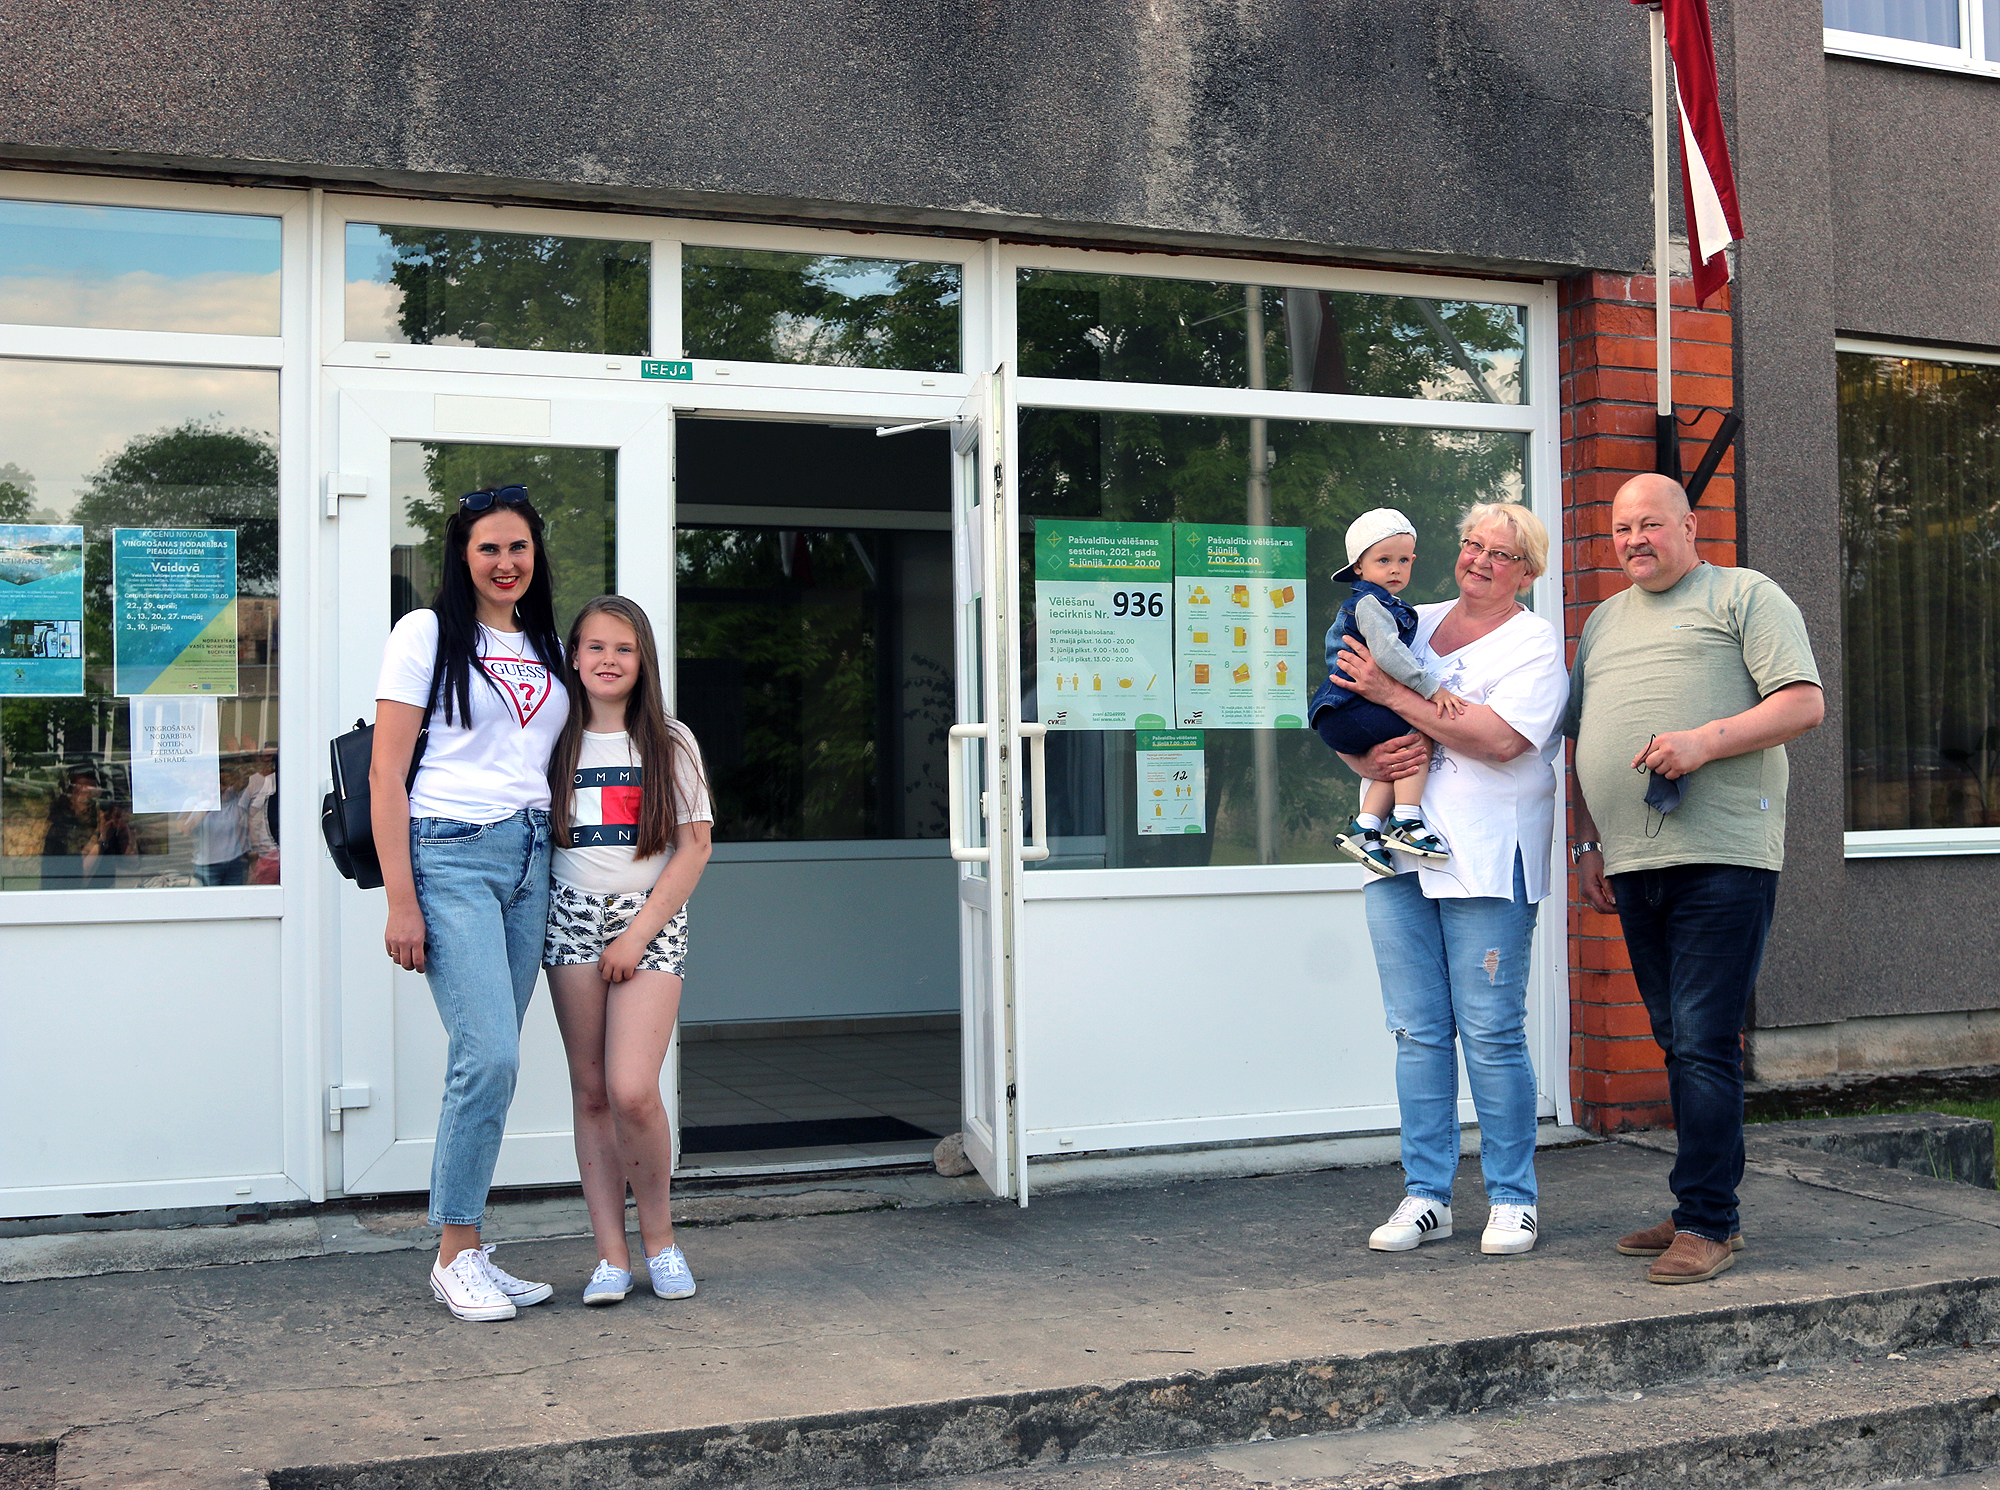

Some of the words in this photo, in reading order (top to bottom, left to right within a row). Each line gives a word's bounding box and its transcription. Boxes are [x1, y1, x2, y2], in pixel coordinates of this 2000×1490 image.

[645, 363, 687, 376] IEEJA
[122, 539, 178, 547] VINGROŠANAS
[180, 540, 228, 548] NODARBĪBAS
[1068, 535, 1116, 545] Pašvaldību
[1117, 536, 1160, 546] vēlēšanas
[1207, 536, 1252, 545] Pašvaldību
[1068, 547, 1109, 557] sestdien,
[1109, 548, 1133, 556] 2021.
[1134, 548, 1157, 558] gada
[1069, 558, 1077, 566] 5.
[1107, 559, 1128, 567] 7.00
[1134, 559, 1161, 568] 20.00
[1207, 556, 1227, 564] 7.00
[1233, 557, 1260, 565] 20.00
[151, 562, 200, 572] Vaidavā
[1187, 584, 1192, 592] 1
[1263, 586, 1269, 594] 3
[126, 602, 142, 610] 22.,
[1048, 596, 1095, 607] Vēlēšanu
[1112, 591, 1164, 618] 936
[1049, 608, 1093, 618] iecirknis
[1094, 610, 1110, 619] Nr.
[1187, 624, 1193, 632] 4
[1224, 625, 1230, 633] 5
[1187, 660, 1193, 668] 7
[490, 662, 546, 679] GUESS
[144, 724, 196, 732] VINGROŠANAS
[573, 771, 631, 784] OMM
[1173, 770, 1188, 781] 12
[573, 830, 631, 843] EAN
